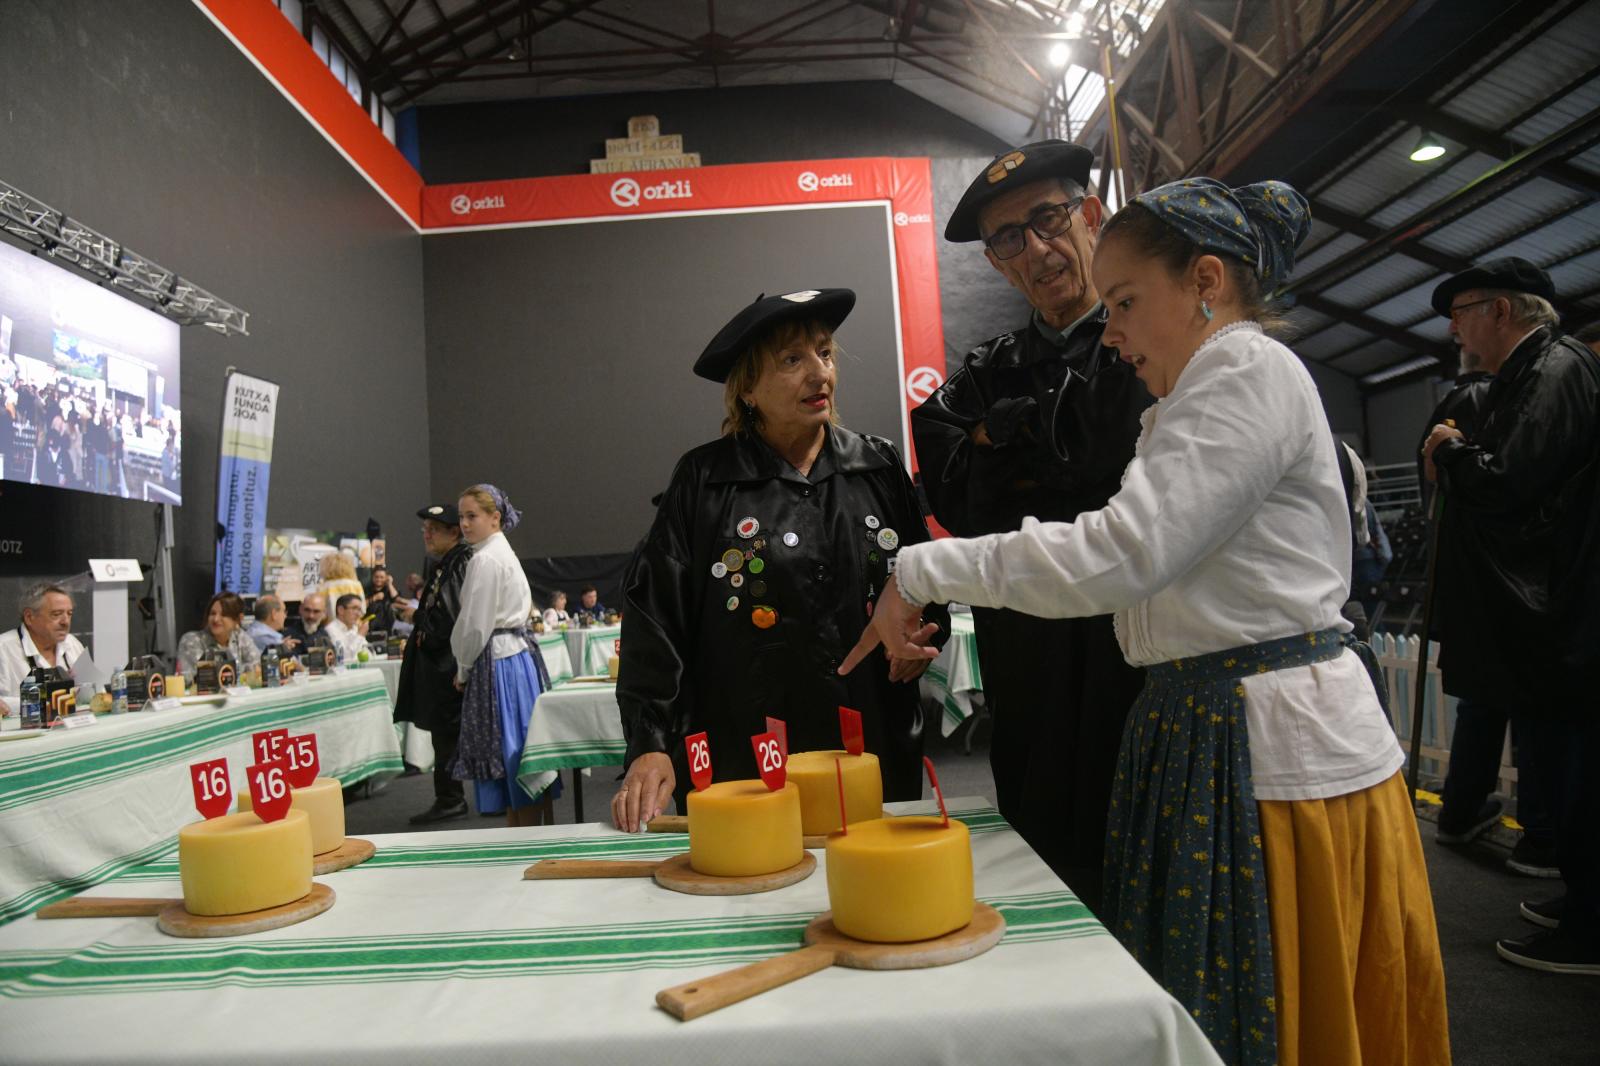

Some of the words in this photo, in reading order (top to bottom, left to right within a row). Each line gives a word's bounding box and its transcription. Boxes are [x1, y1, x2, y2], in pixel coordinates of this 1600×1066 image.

[643, 180, 693, 200] orkli
[819, 173, 854, 187] orkli
[473, 194, 506, 210] orkli
[0, 539, 23, 554] OTZ
[222, 531, 235, 590] ipuzkoa
[303, 561, 320, 575] ART
[259, 736, 284, 763] 15
[286, 741, 314, 771] 15
[691, 739, 710, 773] 26
[759, 739, 783, 773] 26
[198, 767, 227, 800] 16
[256, 768, 286, 803] 16
